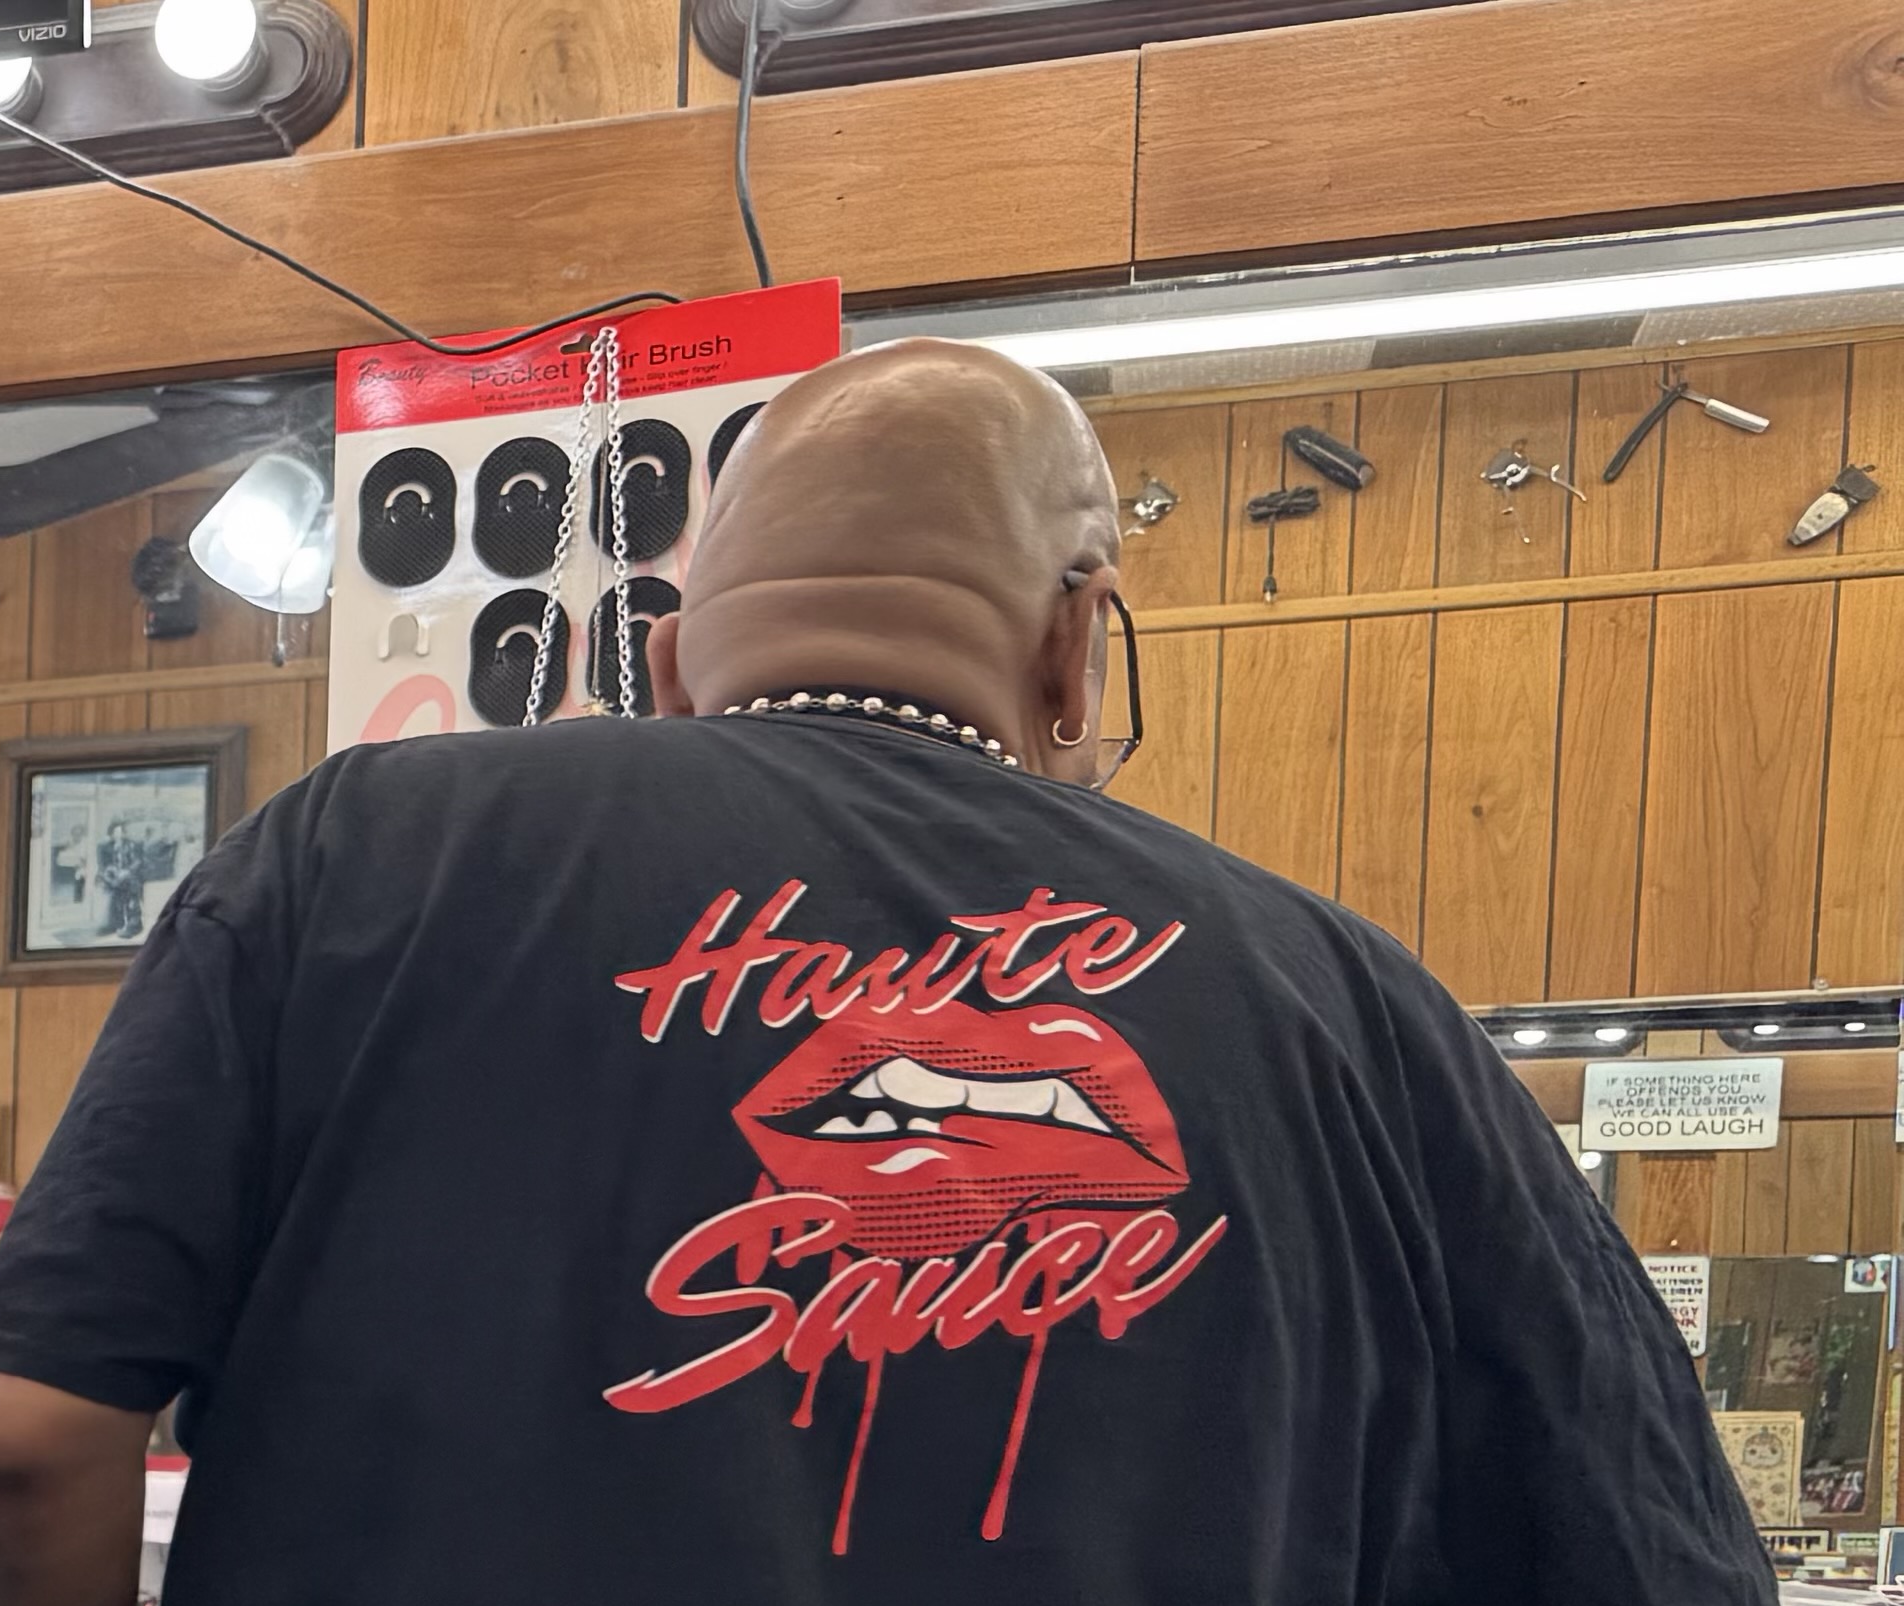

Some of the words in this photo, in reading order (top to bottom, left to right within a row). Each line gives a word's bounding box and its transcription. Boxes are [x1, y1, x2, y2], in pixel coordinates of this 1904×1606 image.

[18, 23, 67, 42] VIZIO
[469, 362, 570, 390] Pocket
[648, 334, 733, 366] Brush
[614, 879, 1186, 1043] Haute
[1606, 1076, 1618, 1087] IF
[1624, 1074, 1714, 1087] SOMETHING
[1719, 1073, 1761, 1084] HERE
[1626, 1085, 1702, 1097] OFFENDS
[1708, 1084, 1742, 1095] YOU
[1598, 1097, 1655, 1108] PLEASE
[1659, 1096, 1687, 1107] LET
[1692, 1096, 1713, 1106] US
[1717, 1093, 1767, 1105] KNOW
[1611, 1107, 1635, 1119] WE
[1640, 1107, 1672, 1118] CAN
[1677, 1106, 1702, 1117] ALL
[1708, 1106, 1737, 1117] USE
[1743, 1105, 1754, 1116] A
[1599, 1119, 1673, 1138] GOOD
[1680, 1117, 1765, 1136] LAUGH
[1648, 1265, 1698, 1274] NOTICE
[602, 1191, 1228, 1413] Sauce
